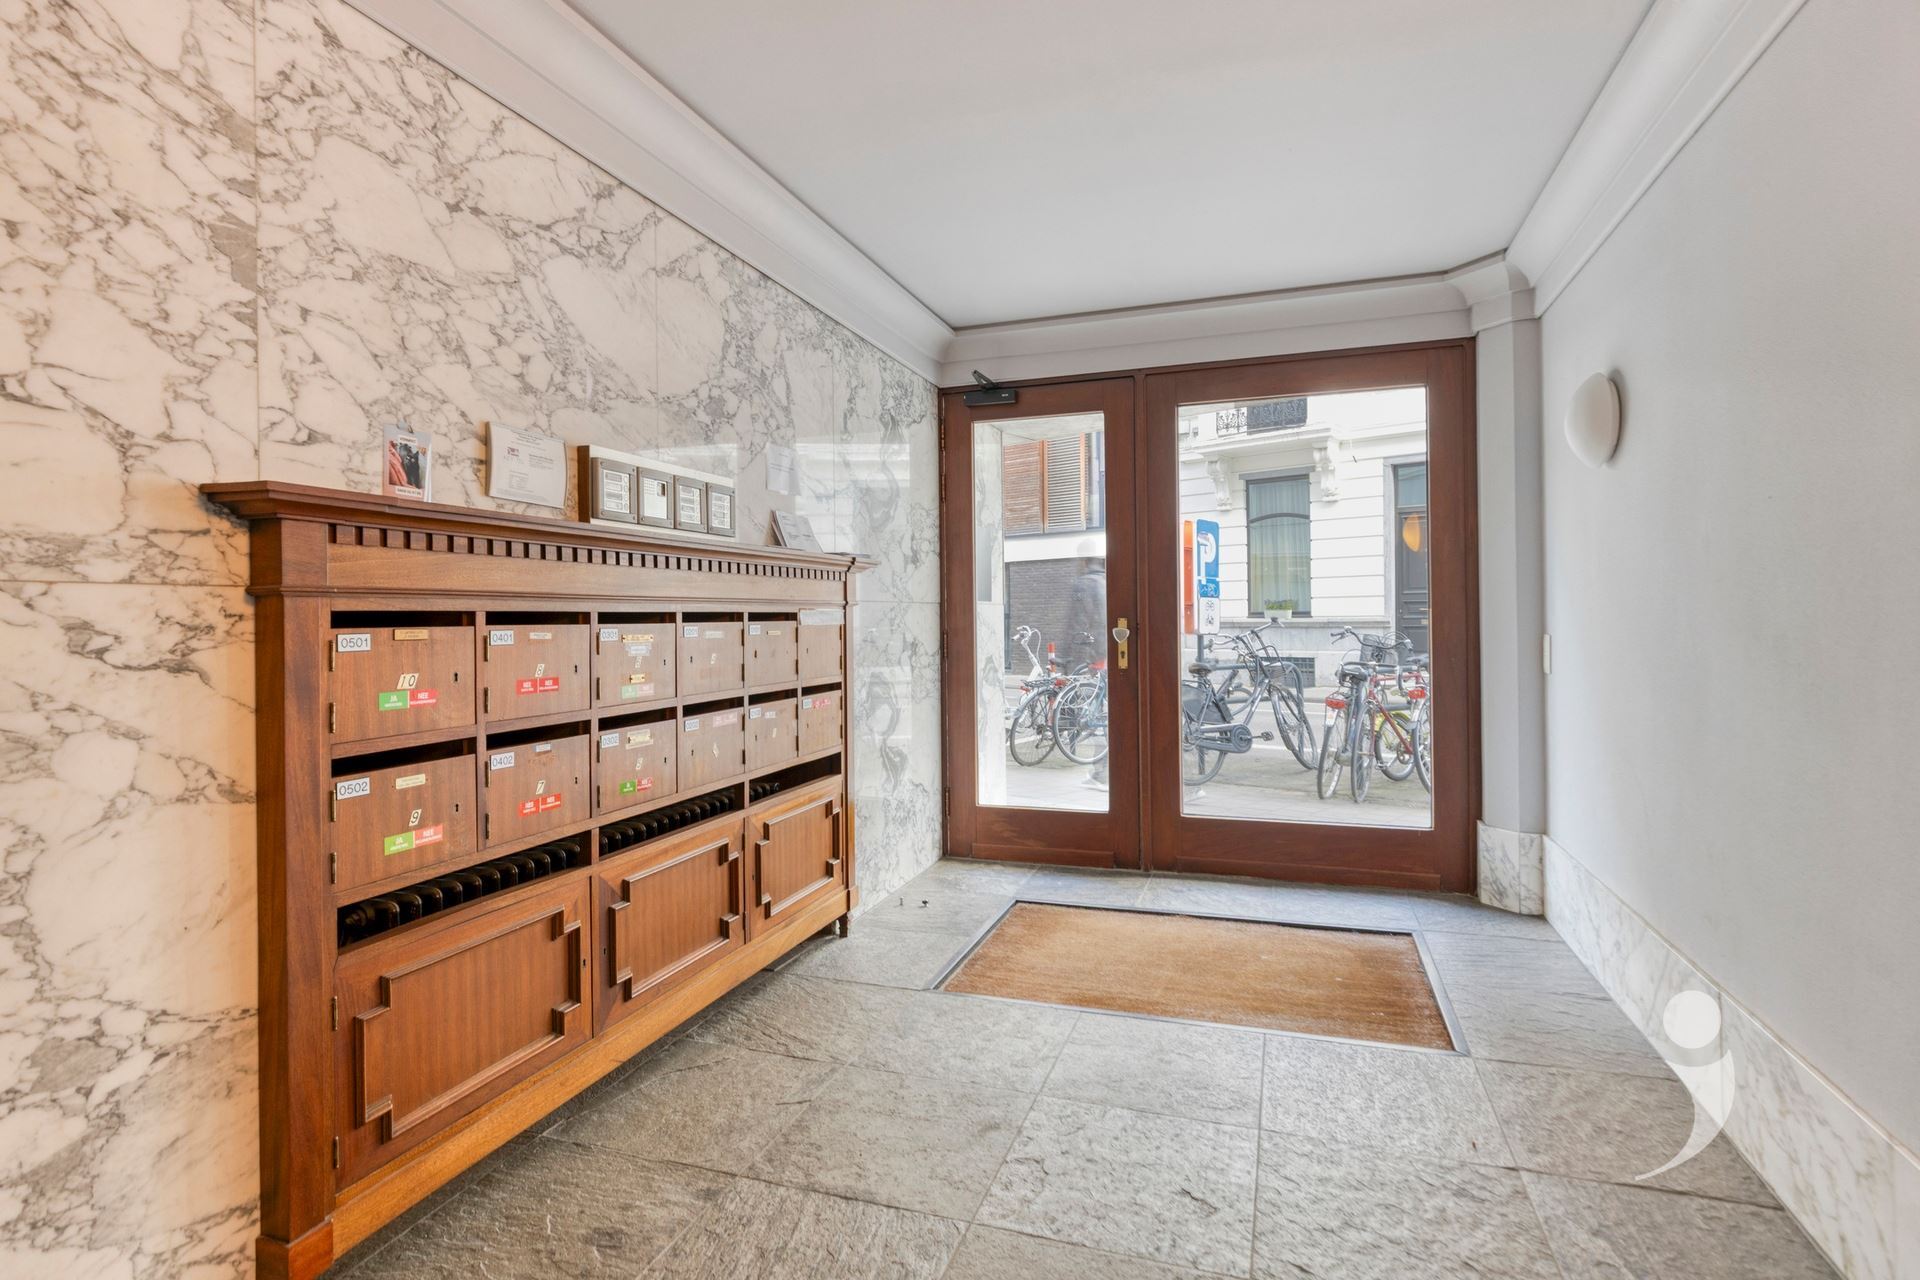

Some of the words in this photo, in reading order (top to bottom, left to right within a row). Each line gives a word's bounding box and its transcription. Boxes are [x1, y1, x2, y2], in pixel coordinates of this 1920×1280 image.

[340, 637, 369, 649] 0501
[492, 633, 512, 643] 0401
[400, 674, 416, 688] 10
[417, 692, 429, 700] NEE
[492, 755, 513, 767] 0402
[339, 781, 368, 796] 0502
[410, 811, 420, 824] 9
